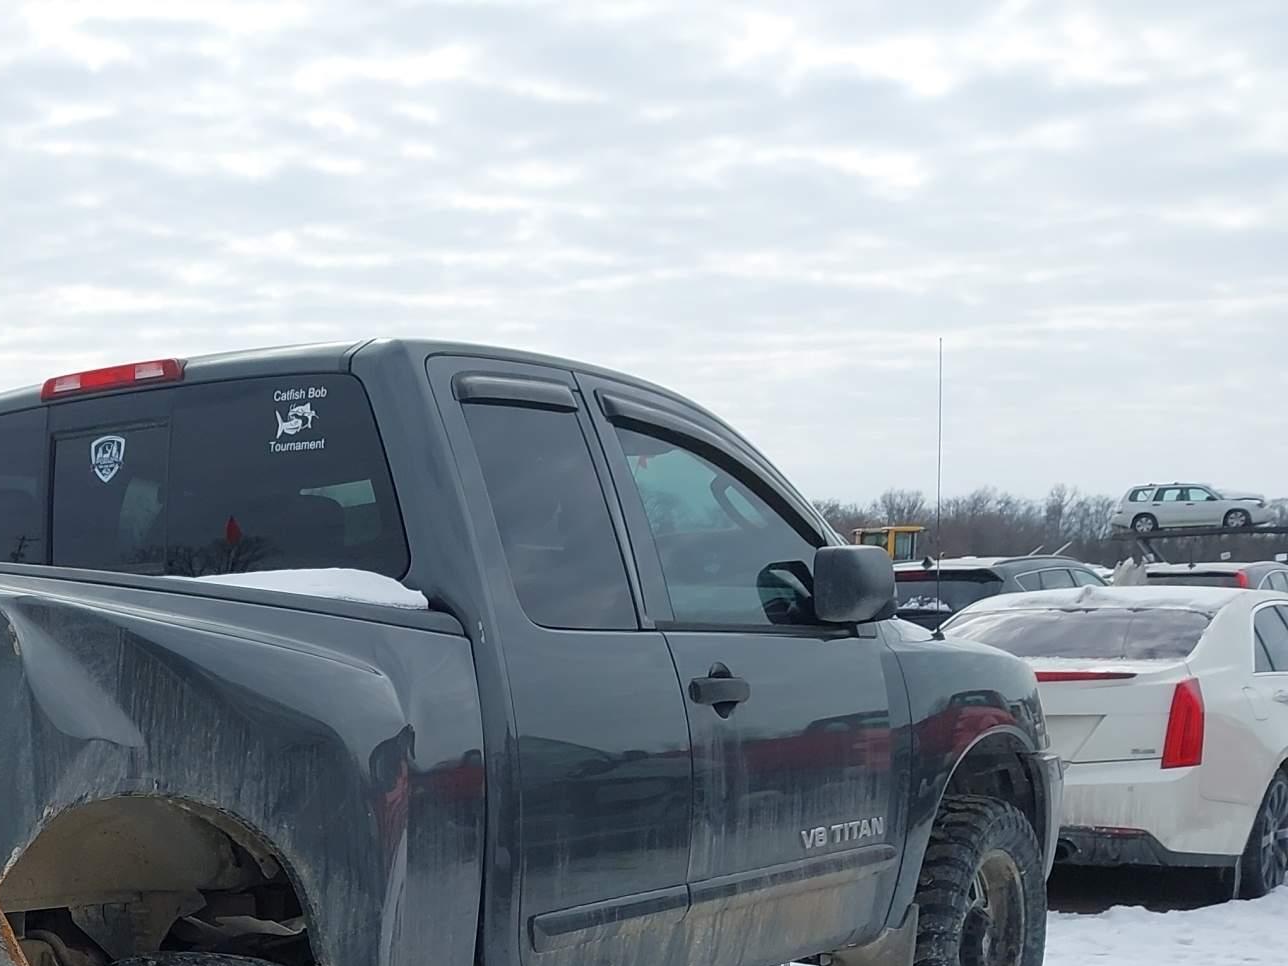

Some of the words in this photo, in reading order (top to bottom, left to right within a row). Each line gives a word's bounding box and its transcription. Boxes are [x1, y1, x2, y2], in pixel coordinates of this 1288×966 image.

[273, 388, 306, 402] Catfish
[308, 386, 328, 399] Bob
[269, 438, 325, 453] Tournament
[800, 826, 827, 849] V8
[831, 816, 884, 844] TITAN
